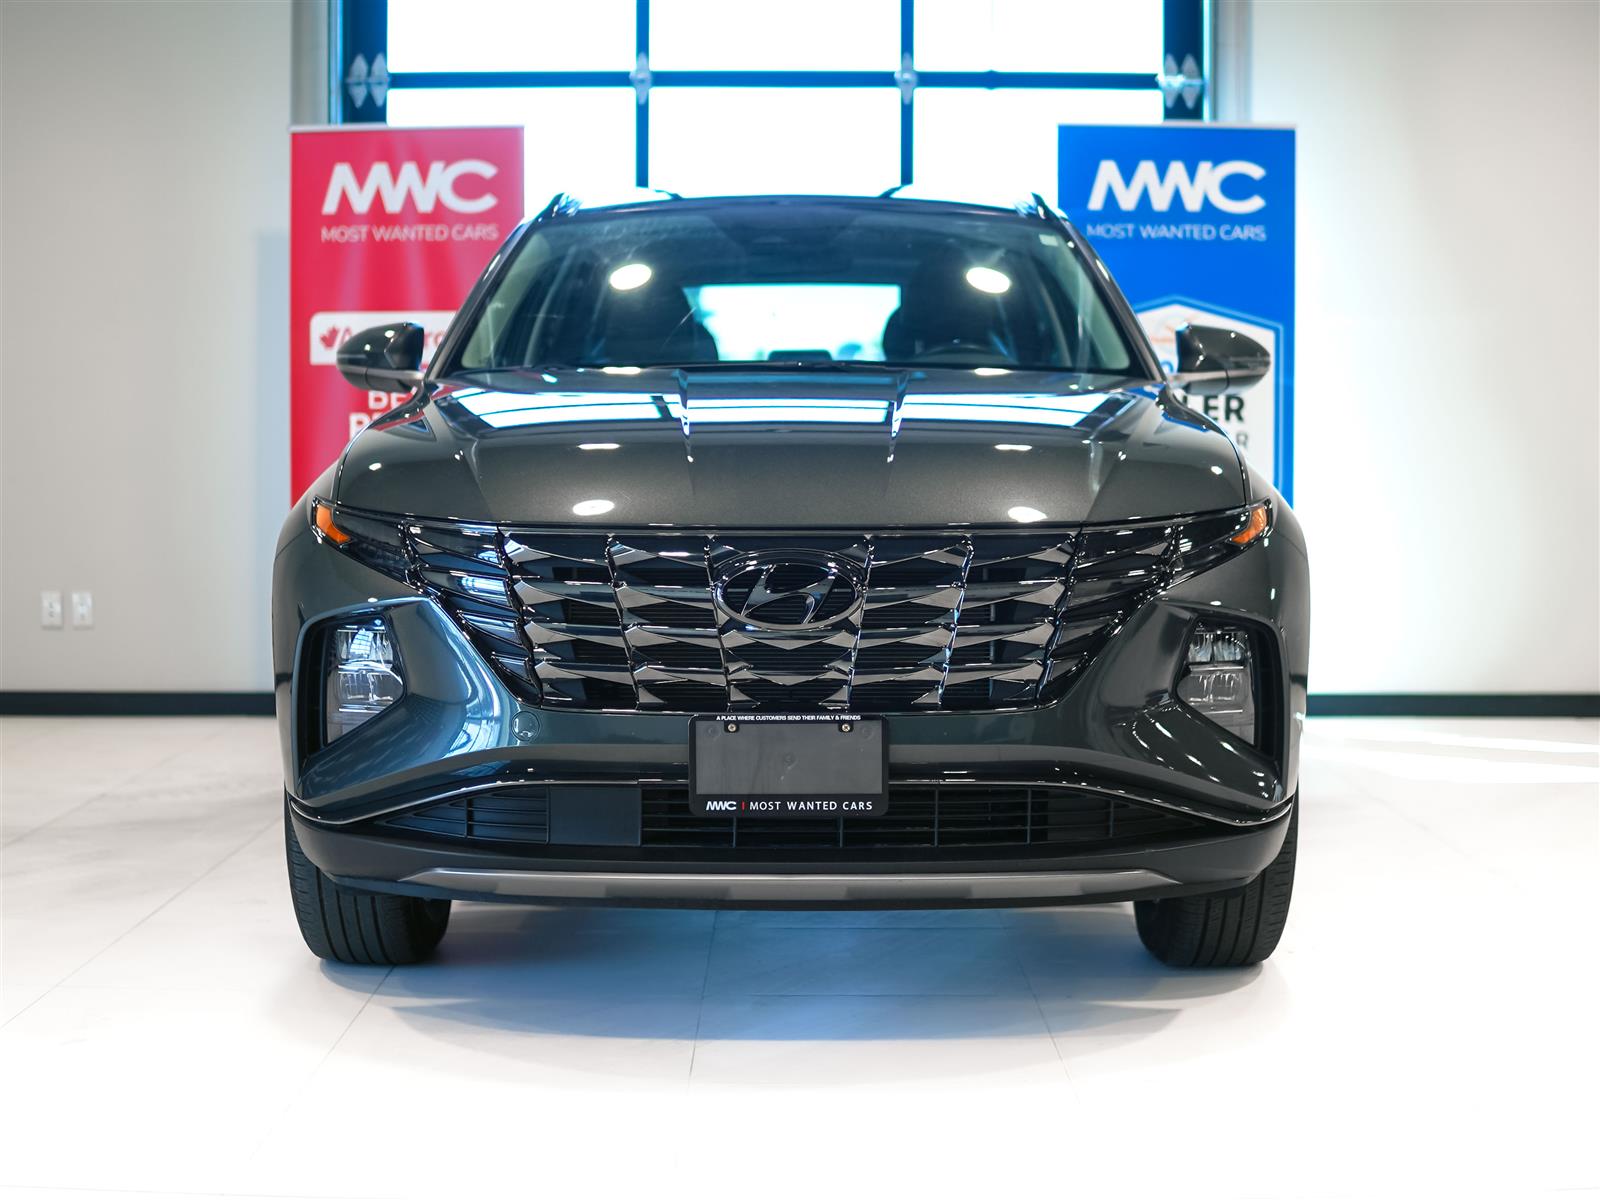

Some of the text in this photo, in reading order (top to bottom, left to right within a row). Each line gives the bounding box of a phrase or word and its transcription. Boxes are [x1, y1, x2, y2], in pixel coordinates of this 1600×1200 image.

[321, 159, 499, 215] MWC
[1087, 159, 1266, 214] MWC
[320, 223, 499, 243] MOST WANTED CARS
[1086, 224, 1267, 242] MOST WANTED CARS
[705, 800, 873, 811] MWC MOST WANTED CARS
